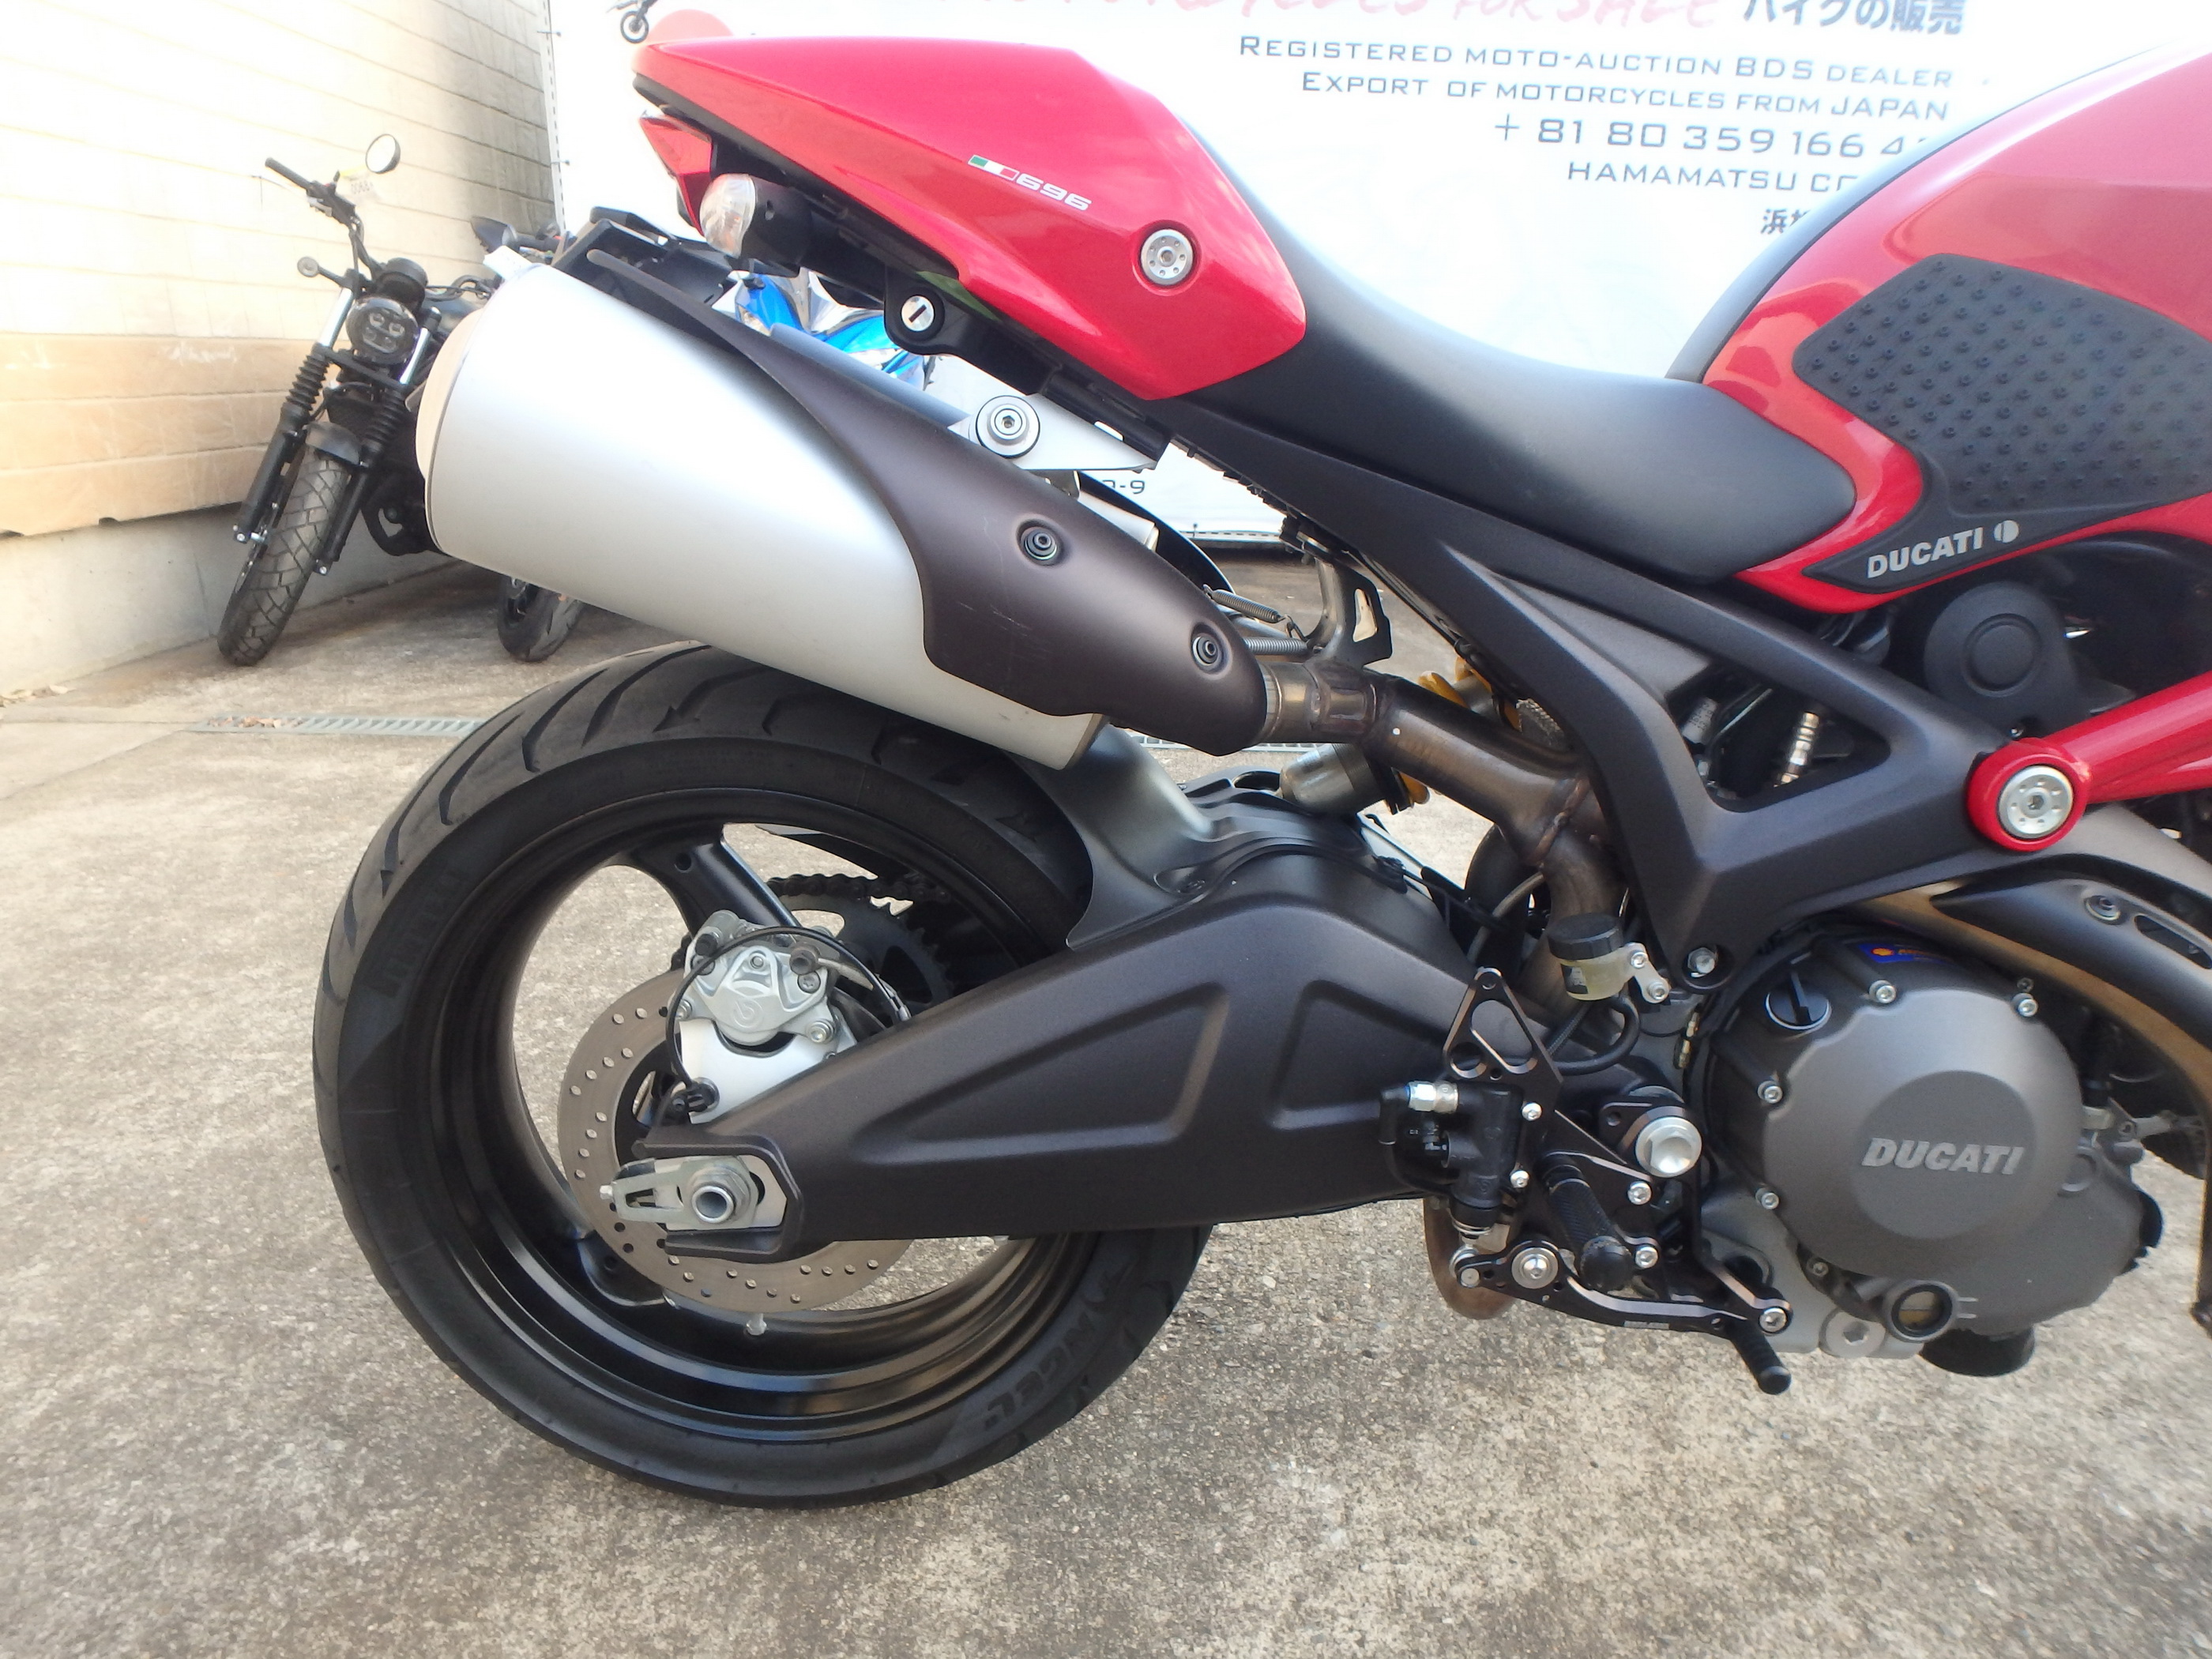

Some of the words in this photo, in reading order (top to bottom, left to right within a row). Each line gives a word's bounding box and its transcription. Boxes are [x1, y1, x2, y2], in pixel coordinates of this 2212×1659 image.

[1240, 35, 1453, 63] REGISTERED
[1465, 47, 1722, 75] MOTO-AUCTION
[1735, 55, 1814, 80] BDS
[1826, 64, 1954, 88] DEALER
[1302, 71, 1429, 96] EXPORT
[1446, 81, 1488, 98] OF
[1495, 82, 1725, 109] MOTORCYCLES
[1736, 93, 1822, 114] FROM
[1830, 96, 1949, 121] JAPAN
[1537, 117, 1583, 145] 81
[1607, 120, 1668, 148] 80
[1683, 124, 1776, 153] 359
[1793, 130, 1864, 158] 166
[1016, 173, 1093, 211] 696
[1567, 160, 1798, 191] HAMAMATSU
[1867, 527, 1984, 579] DUCATI
[1861, 1137, 2026, 1176] DUCATI
